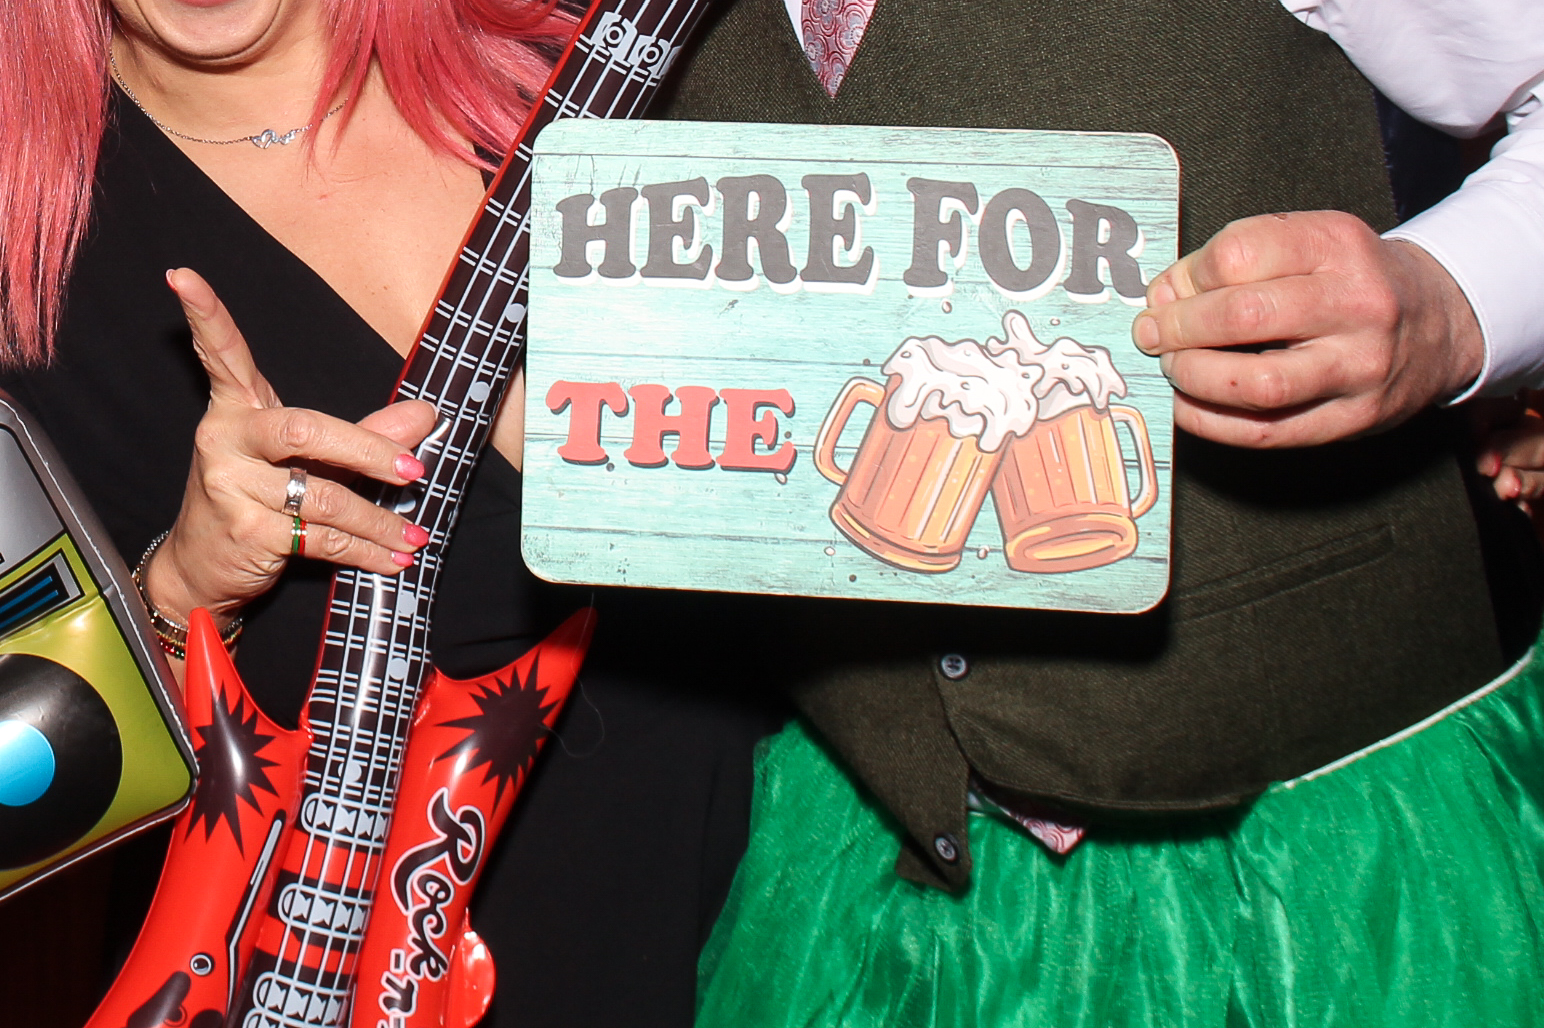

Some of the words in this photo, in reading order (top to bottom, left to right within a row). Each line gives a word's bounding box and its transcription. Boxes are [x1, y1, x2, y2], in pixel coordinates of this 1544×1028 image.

[552, 171, 877, 292] HERE
[902, 176, 1150, 304] FOR
[544, 378, 798, 473] THE
